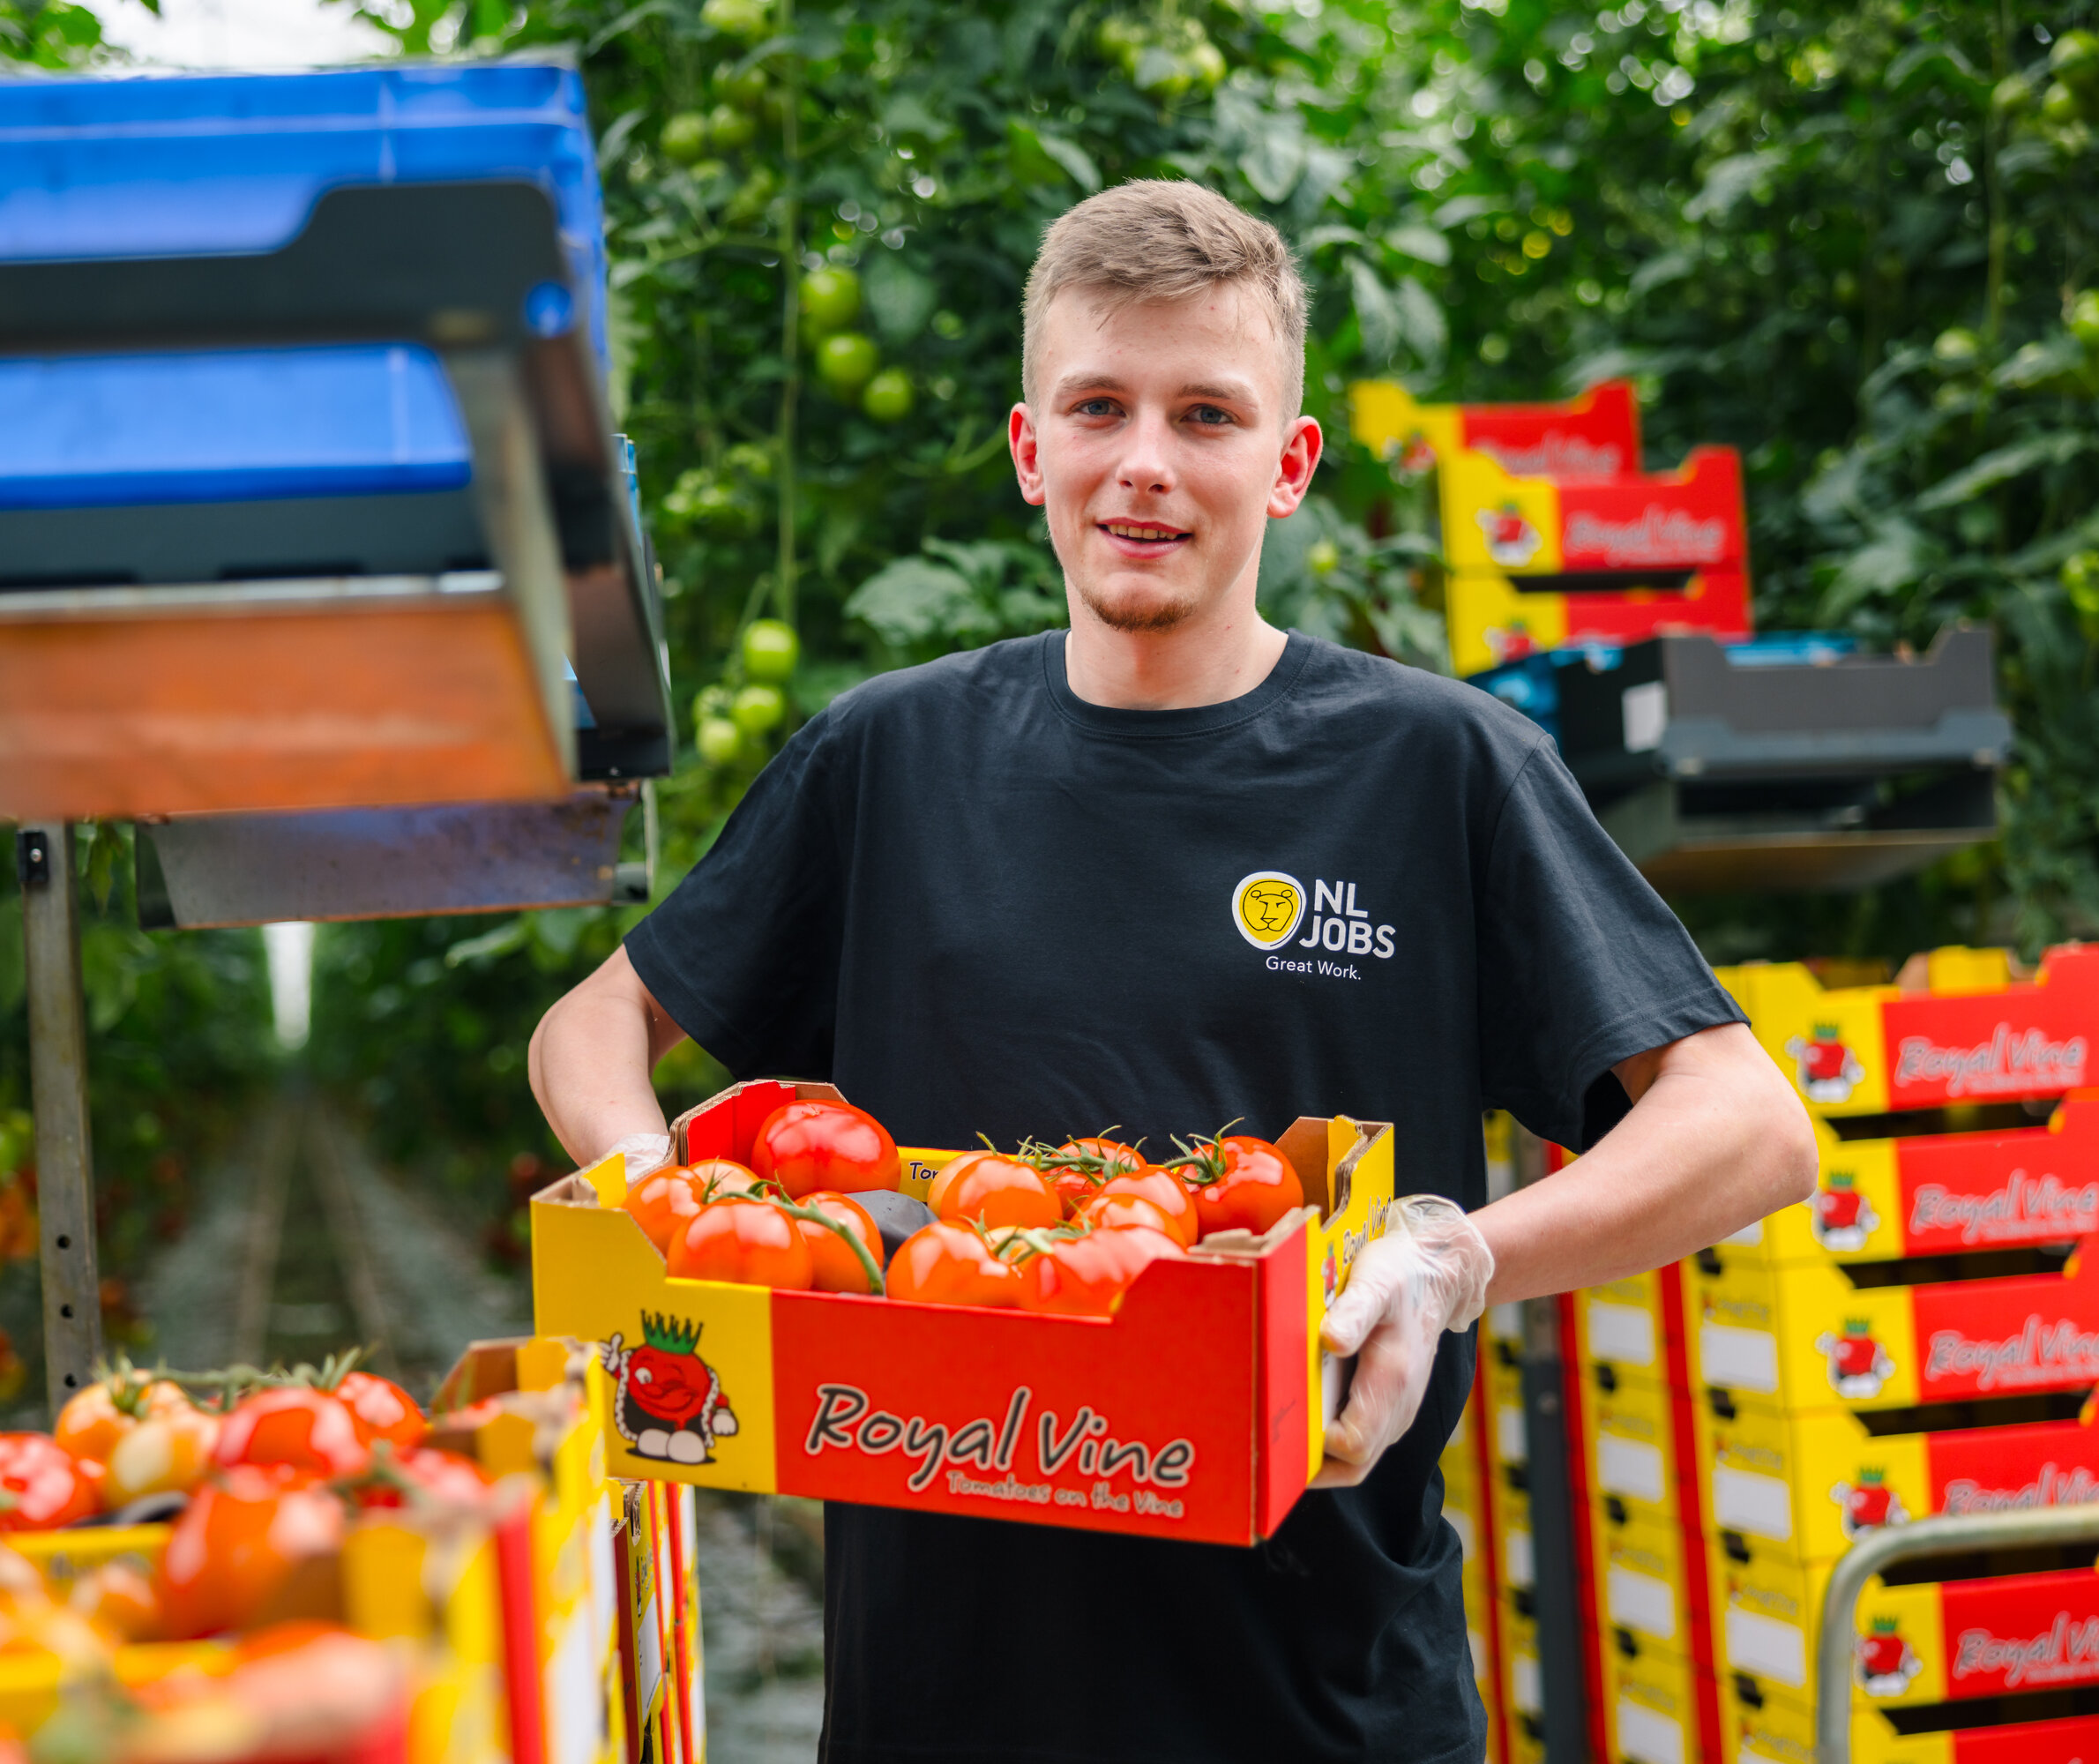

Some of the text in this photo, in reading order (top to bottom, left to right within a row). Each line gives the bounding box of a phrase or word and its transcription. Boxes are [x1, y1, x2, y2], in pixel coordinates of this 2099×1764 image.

[1314, 878, 1369, 918] NL
[1266, 955, 1362, 981] Great Work.
[1298, 916, 1396, 959] JOBS
[1895, 1022, 2088, 1097] Royal Vine
[1909, 1168, 2028, 1245] Royal
[1924, 1313, 2043, 1391] Royal
[804, 1383, 1196, 1492] Royal Vine
[946, 1470, 1184, 1519] Tomatoes on the Vine
[1952, 1611, 2070, 1688] Royal
